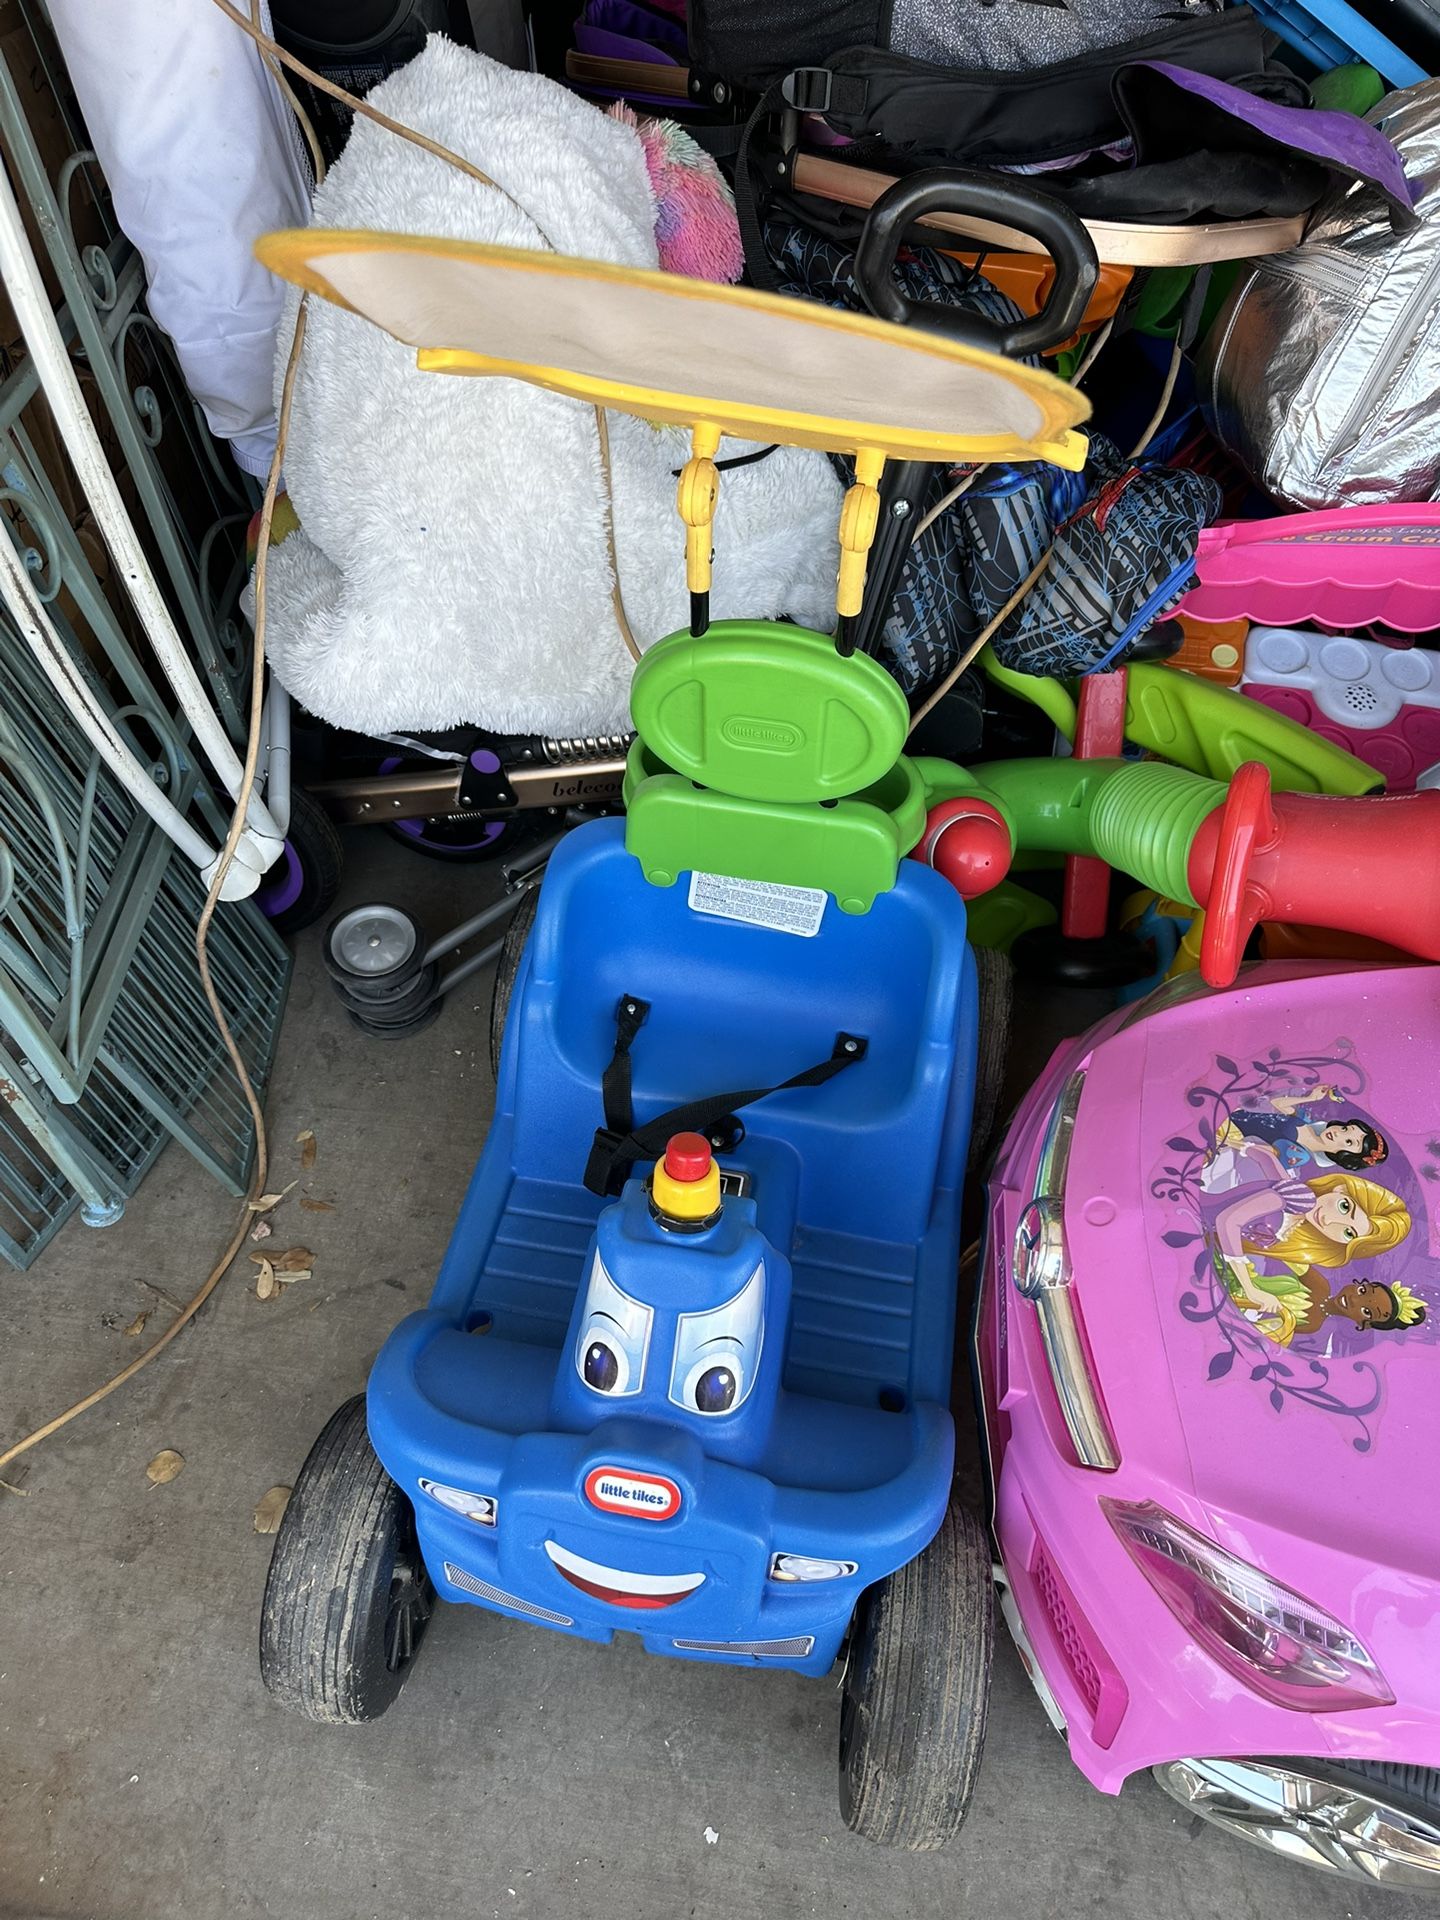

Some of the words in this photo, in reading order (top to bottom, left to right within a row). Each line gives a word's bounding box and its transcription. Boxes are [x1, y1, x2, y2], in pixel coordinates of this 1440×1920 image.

[1304, 534, 1394, 543] Cream
[1401, 535, 1440, 544] Ca
[733, 726, 761, 739] little
[762, 729, 793, 743] tikes
[552, 779, 623, 798] beleco
[600, 1482, 631, 1499] little
[632, 1489, 665, 1505] tikes
